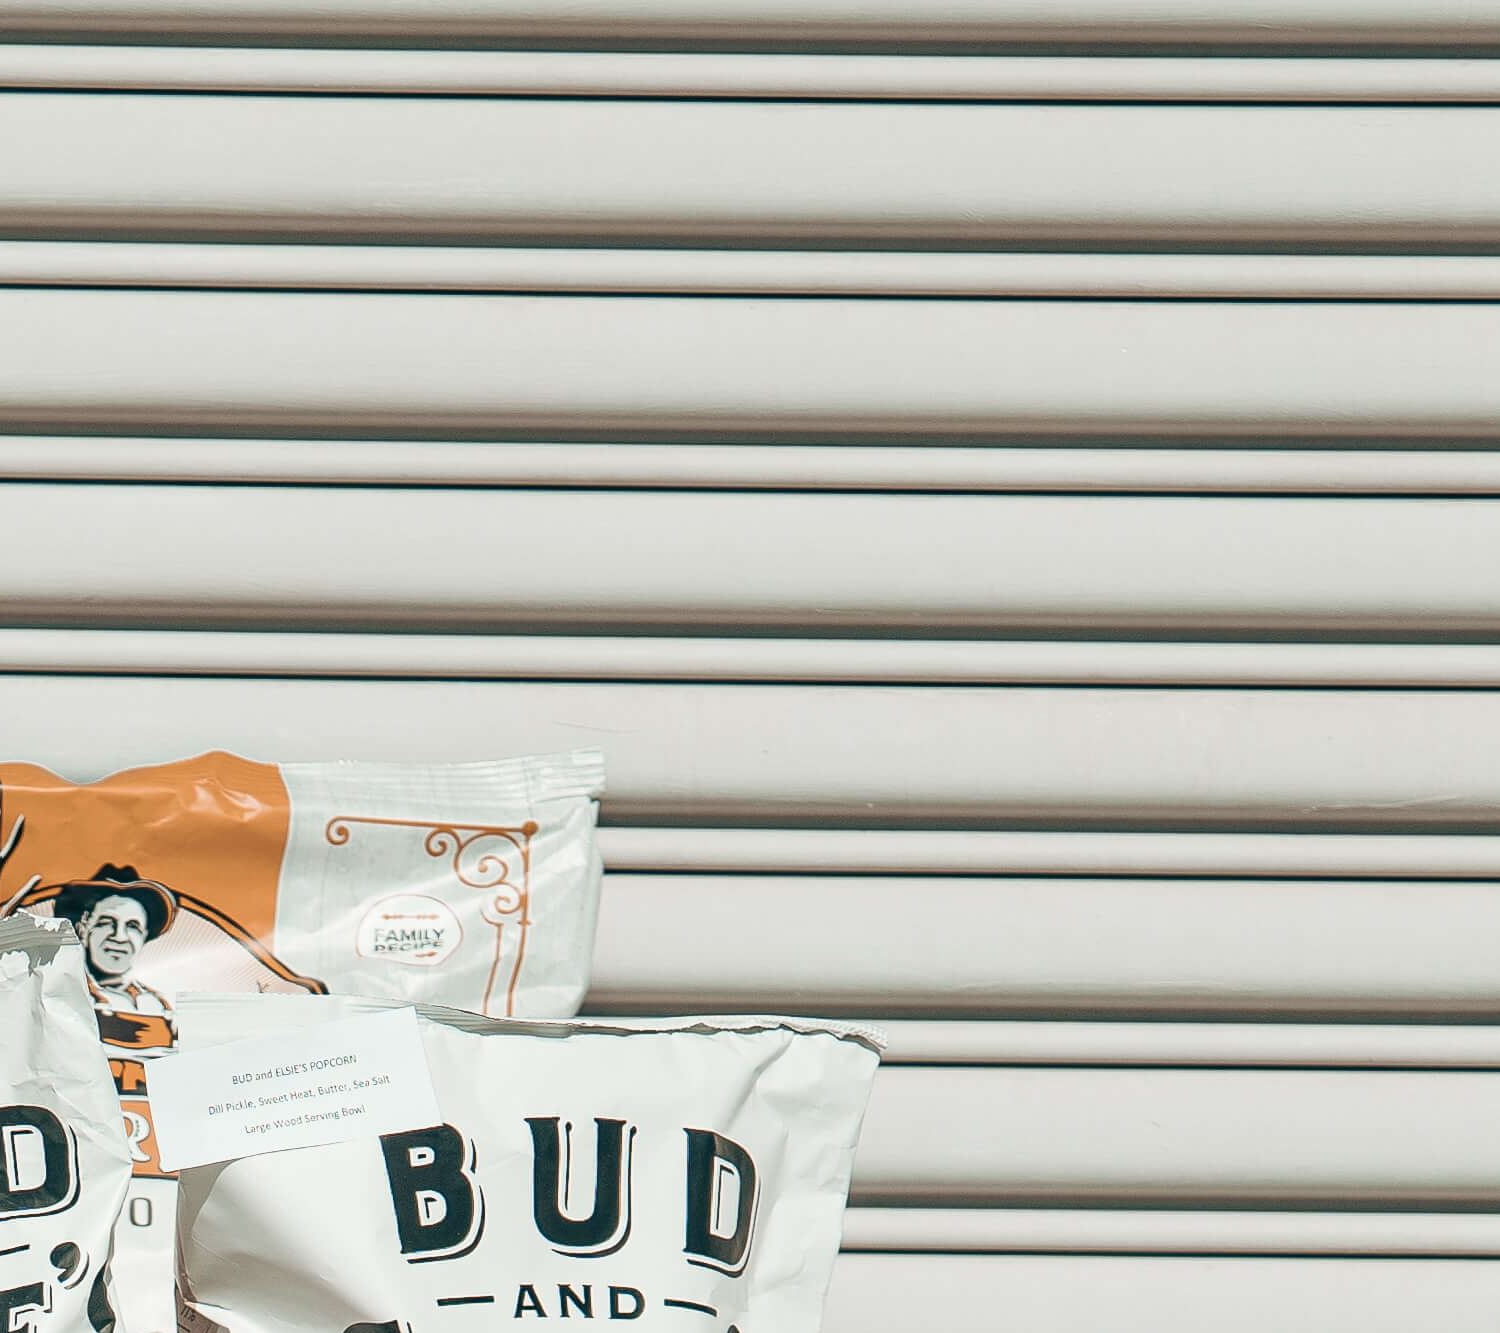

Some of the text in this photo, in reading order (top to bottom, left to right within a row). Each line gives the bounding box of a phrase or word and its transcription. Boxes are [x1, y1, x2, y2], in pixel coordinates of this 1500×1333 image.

[373, 926, 446, 943] FAMILY
[232, 1055, 357, 1085] BUD and ELSIE'S POPCORN
[208, 1104, 225, 1115] Dill
[258, 1094, 289, 1106] Sweet
[353, 1078, 370, 1089] Sea
[372, 1075, 391, 1087] Salt
[244, 1104, 366, 1136] Large Wood Serving Bowl
[378, 1116, 763, 1278] BUD
[513, 1283, 646, 1320] AND
